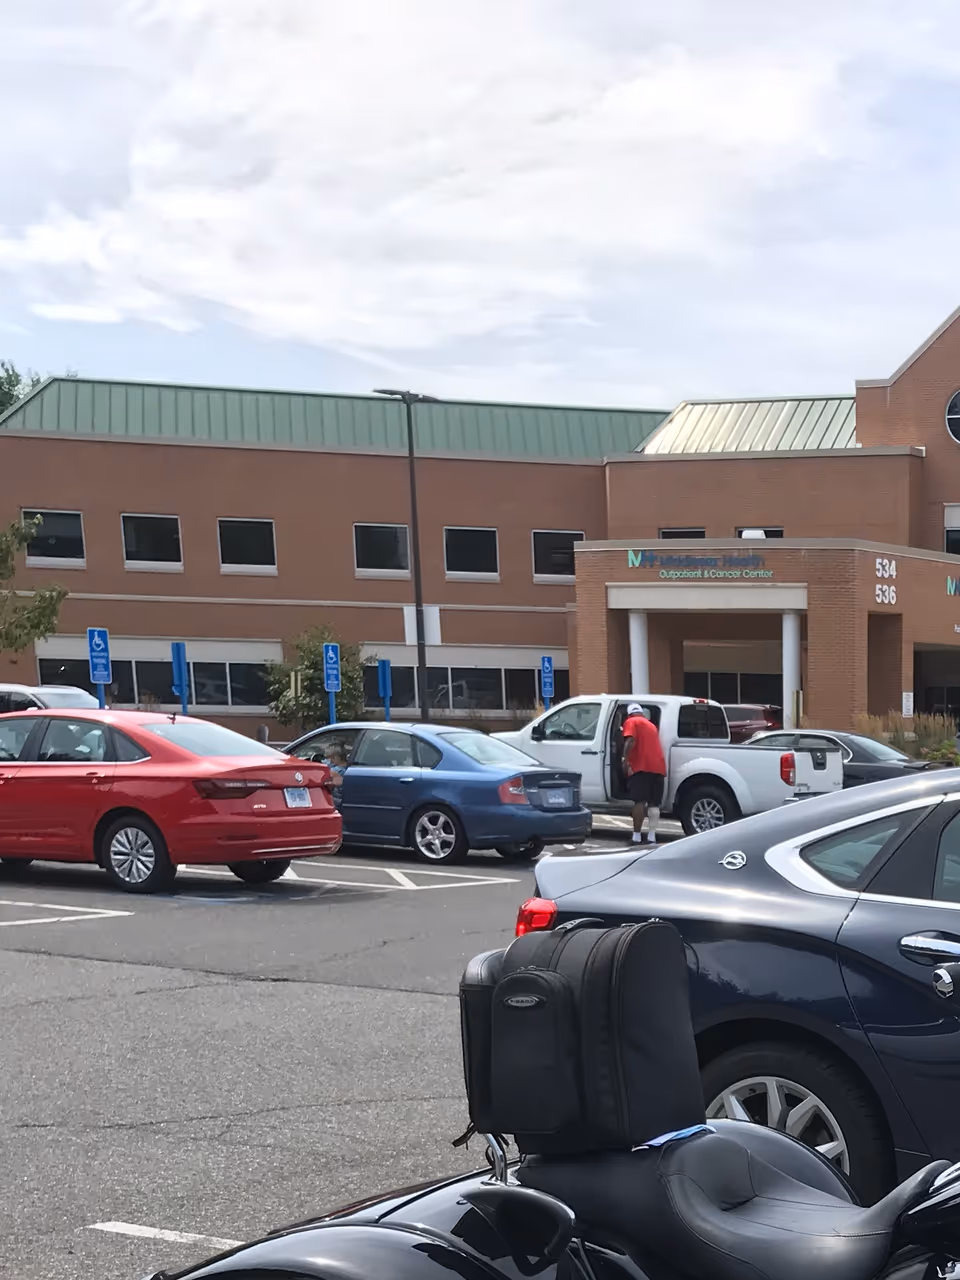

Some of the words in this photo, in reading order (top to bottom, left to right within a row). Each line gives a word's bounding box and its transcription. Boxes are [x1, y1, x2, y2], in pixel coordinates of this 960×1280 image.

[659, 569, 702, 580] Outpatient
[709, 569, 742, 579] Cancer
[743, 569, 774, 579] Center
[875, 558, 897, 579] 534
[875, 584, 897, 605] 536
